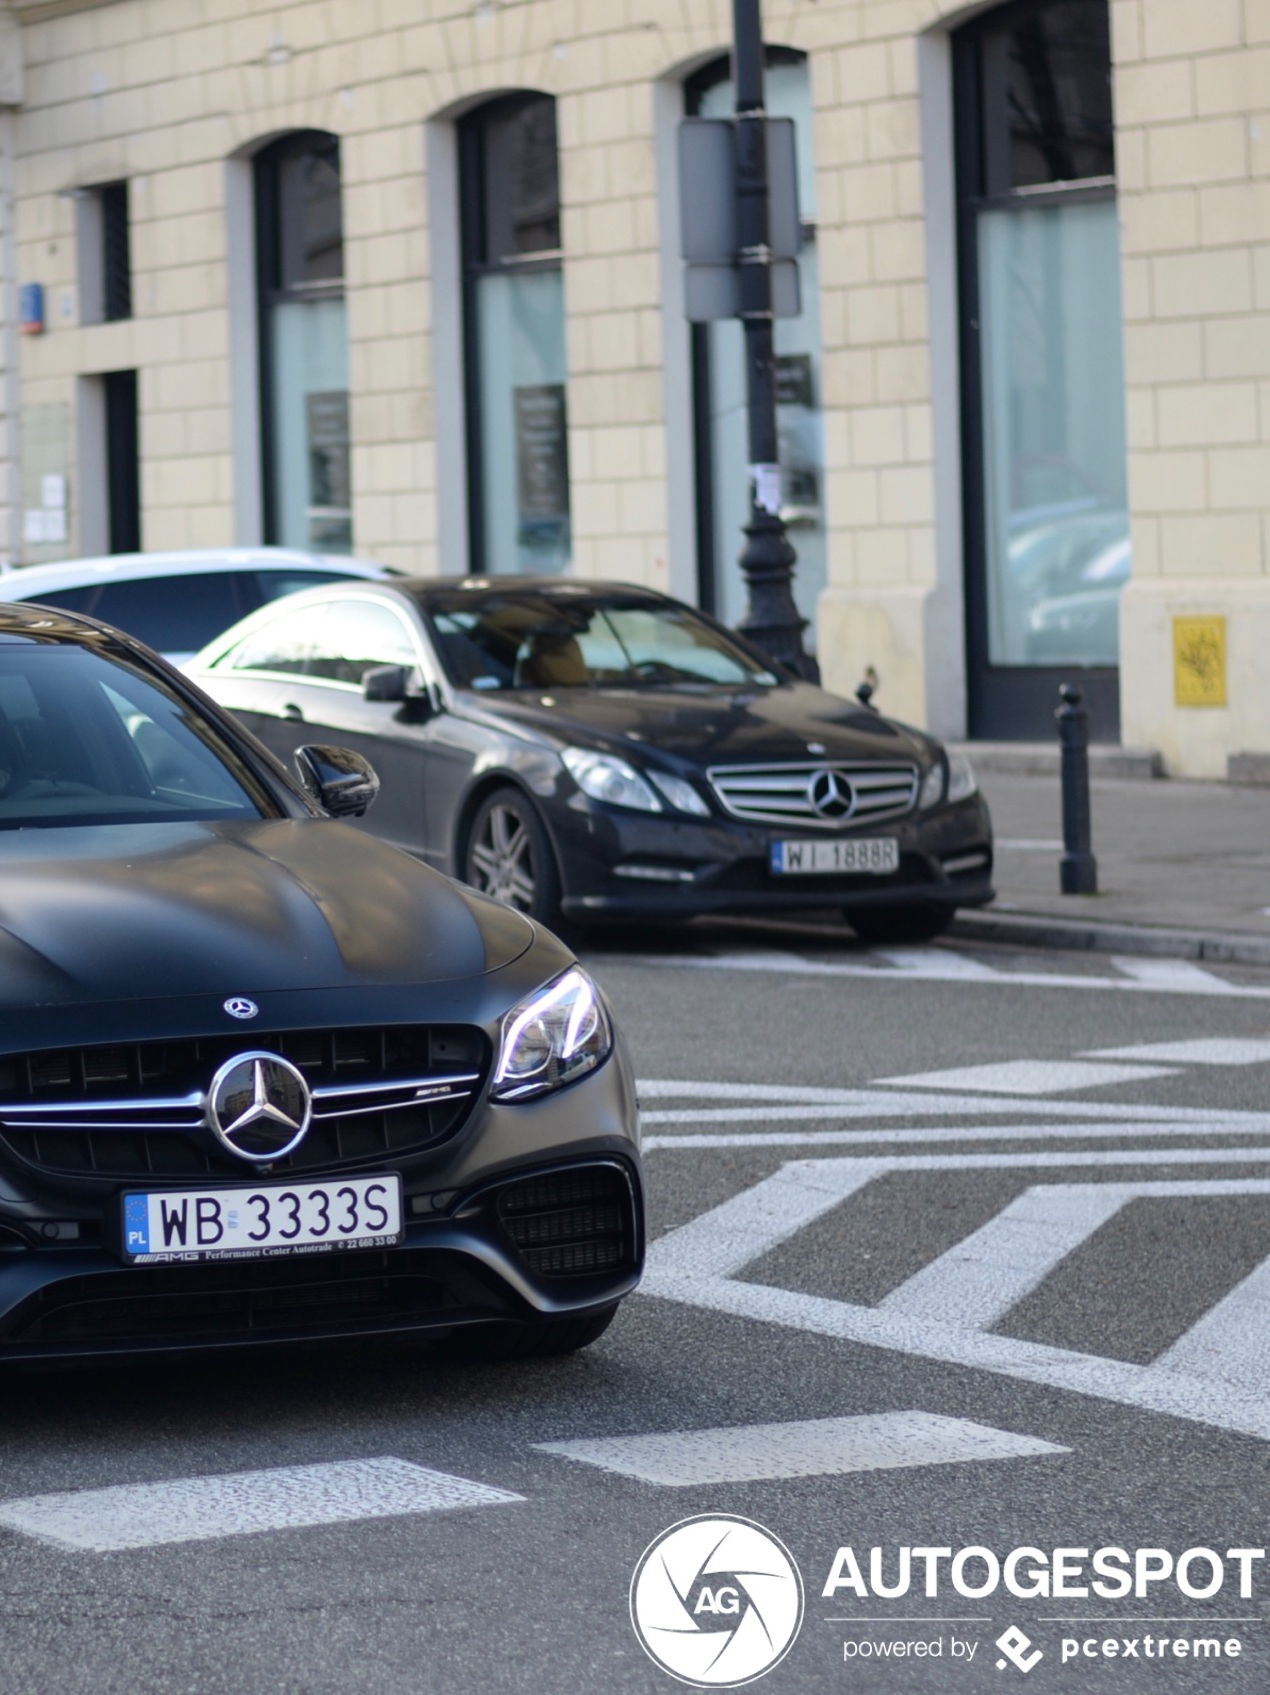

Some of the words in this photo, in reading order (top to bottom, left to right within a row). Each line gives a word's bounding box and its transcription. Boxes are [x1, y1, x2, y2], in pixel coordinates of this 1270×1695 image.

[160, 1197, 224, 1247] WB
[246, 1184, 389, 1242] 3333S
[129, 1231, 147, 1245] PL
[153, 1252, 199, 1262] AMG
[205, 1250, 261, 1260] Performance
[262, 1246, 291, 1257] Center
[292, 1242, 332, 1254] Autotrade
[347, 1239, 357, 1249] 22
[358, 1238, 374, 1248] 660
[375, 1237, 385, 1246] 33
[386, 1235, 397, 1245] 00
